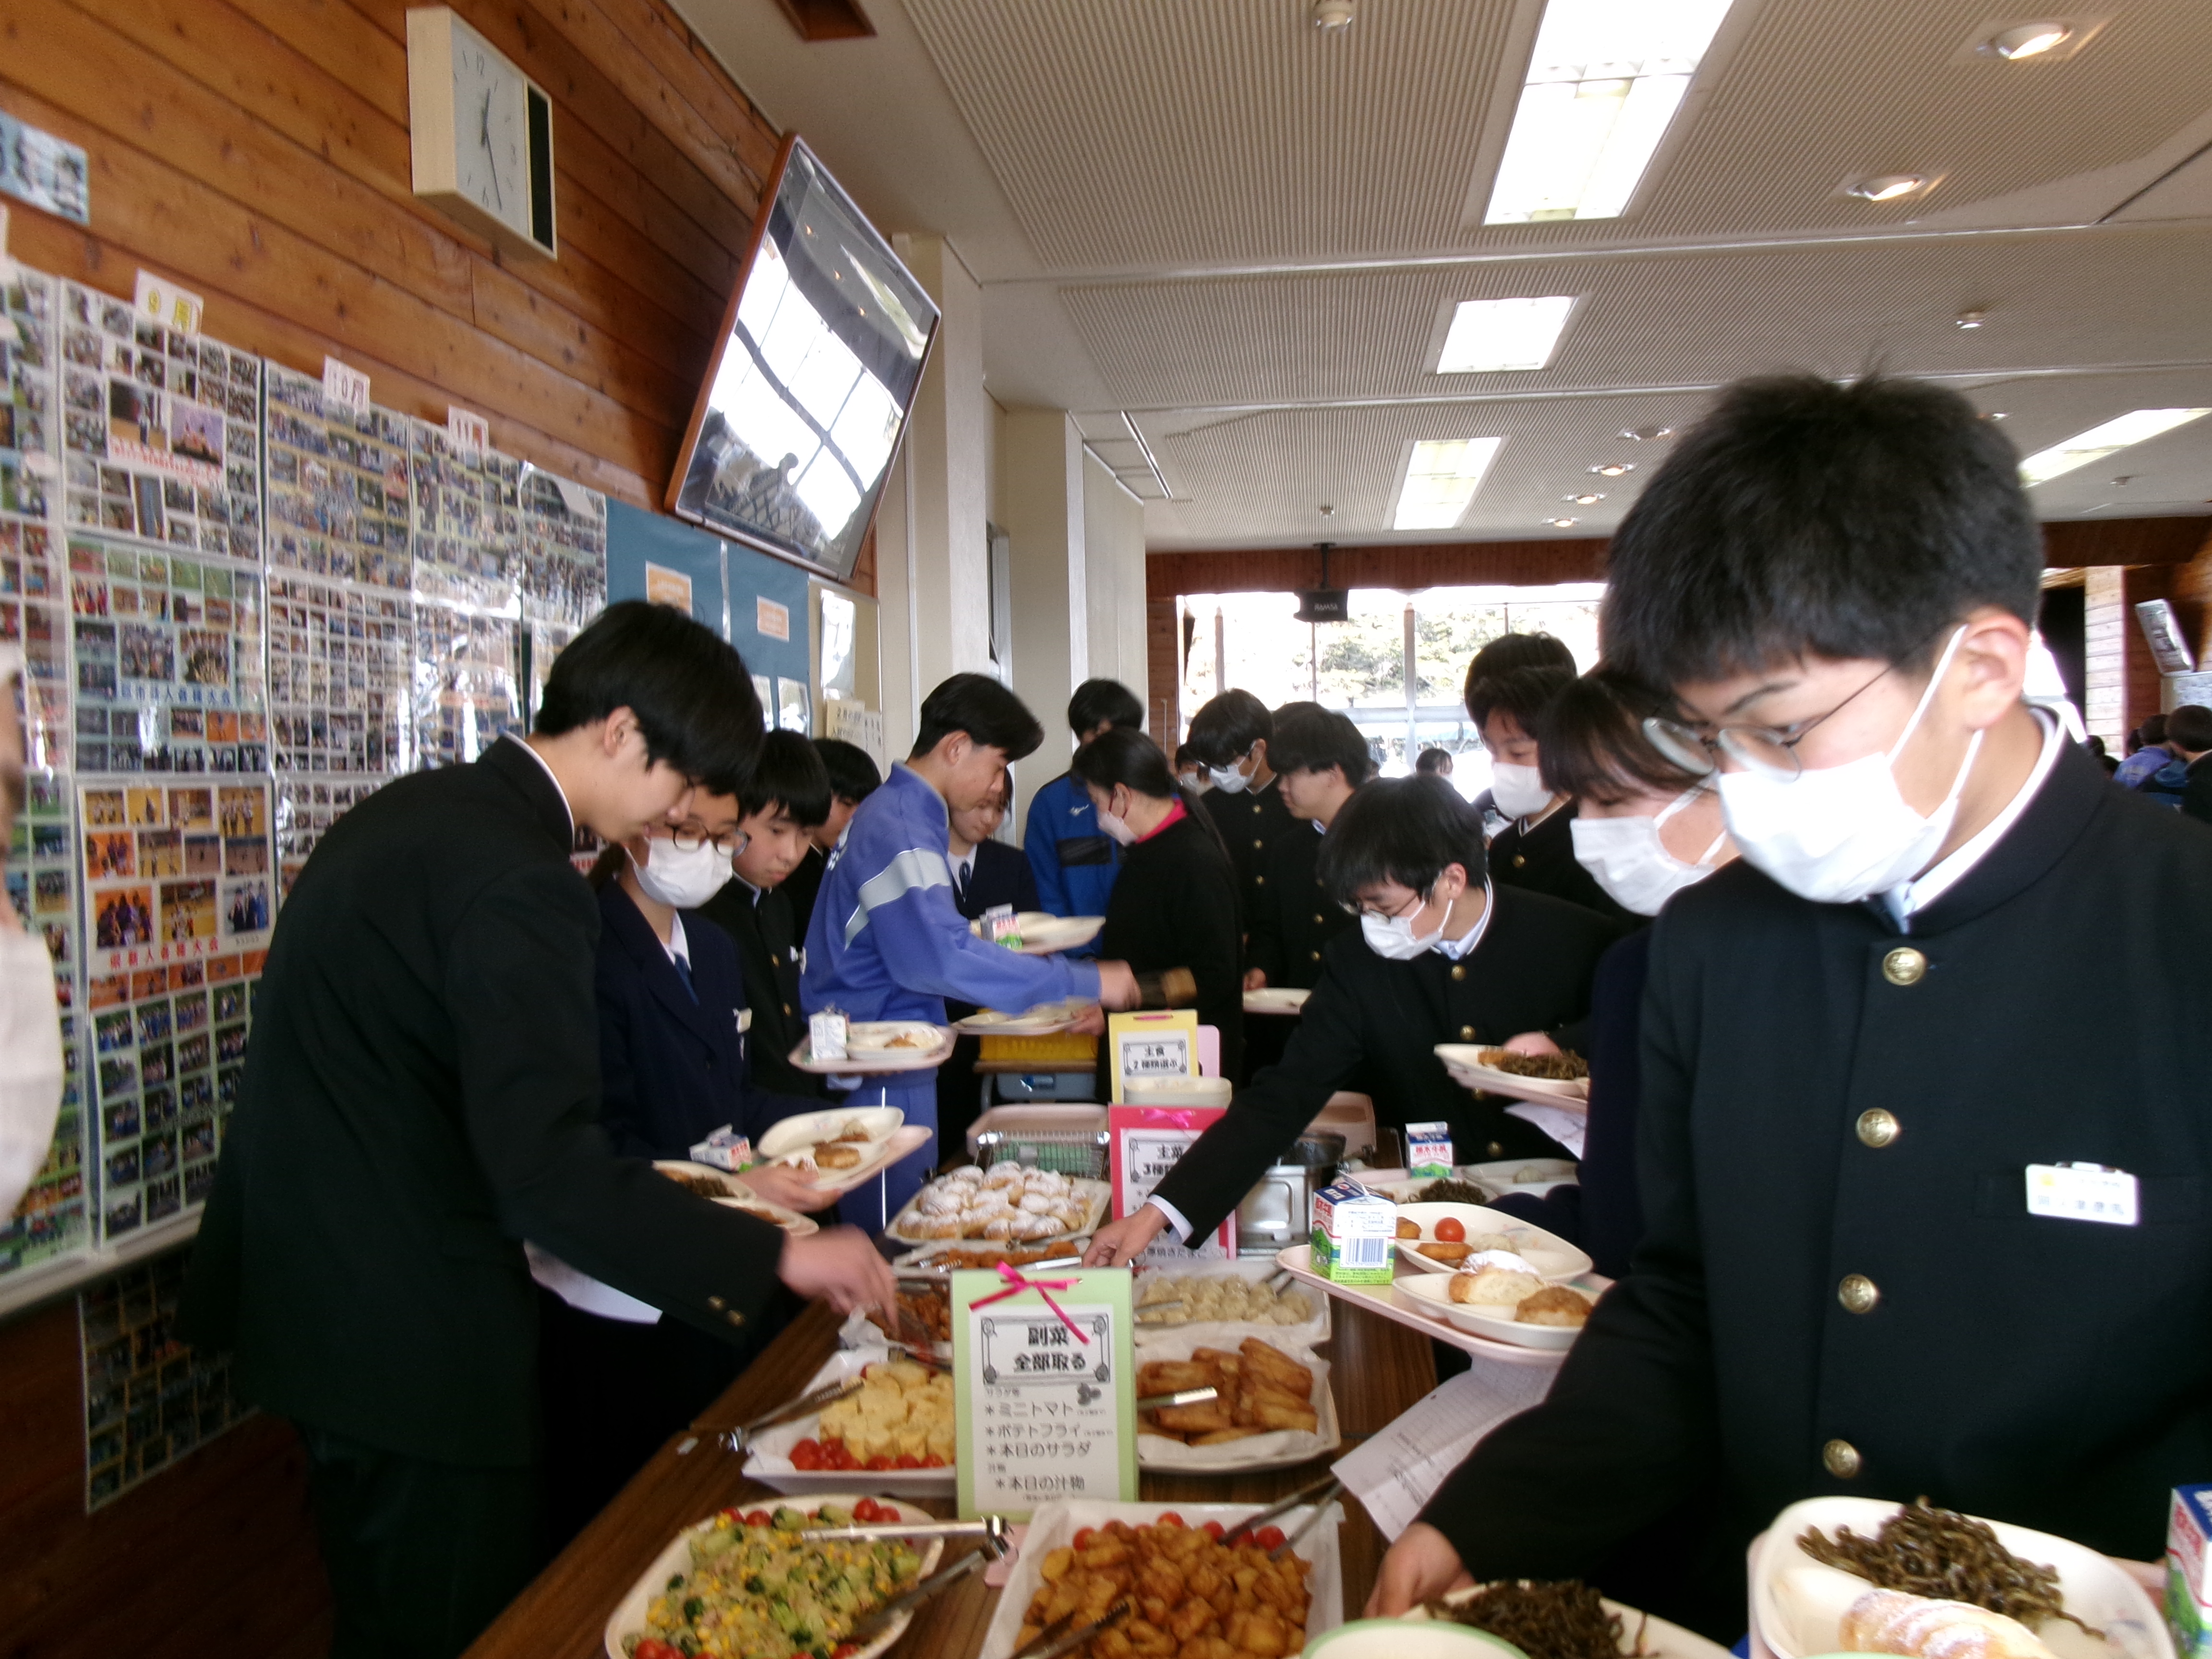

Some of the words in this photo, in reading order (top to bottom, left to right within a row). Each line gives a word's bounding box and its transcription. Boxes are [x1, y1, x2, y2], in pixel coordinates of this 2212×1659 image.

[1314, 602, 1338, 612] RAMSA
[1144, 1045, 1165, 1057] 主食
[1157, 1143, 1184, 1160] 主菜
[1029, 1324, 1070, 1346] 副菜
[1013, 1351, 1086, 1372] 全部取る
[999, 1401, 1073, 1417] ミニトマト
[998, 1422, 1080, 1439] ポテトフライ
[1000, 1441, 1092, 1458] 本日のサラダ
[1009, 1474, 1085, 1491] 本日の汁物
